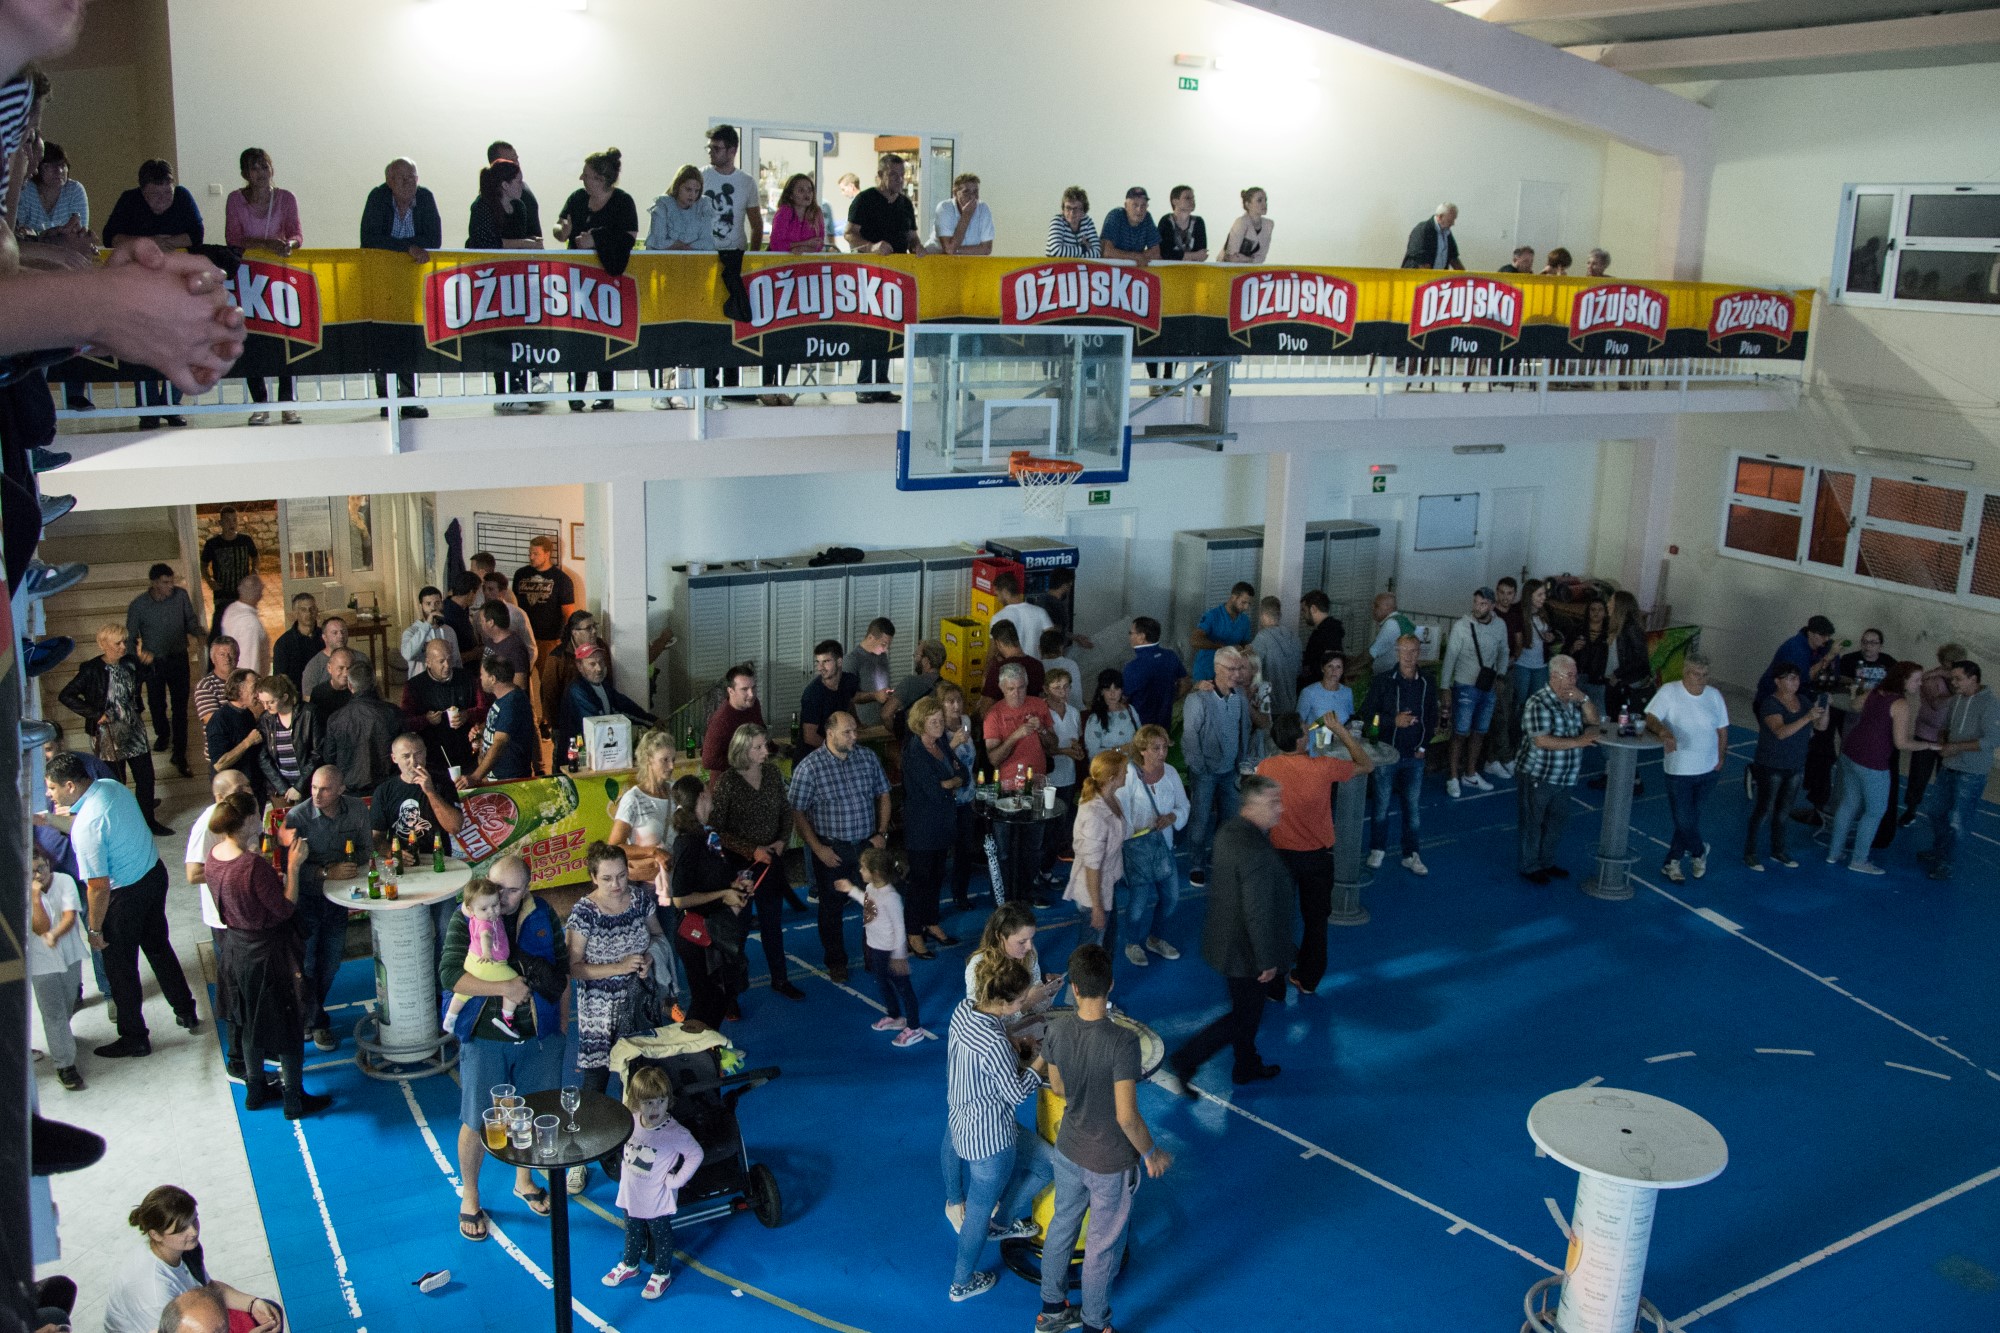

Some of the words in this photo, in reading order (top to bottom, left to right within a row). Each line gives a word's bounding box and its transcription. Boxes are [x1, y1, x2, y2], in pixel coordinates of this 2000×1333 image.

[443, 264, 622, 330] Ožujsko
[749, 265, 904, 328] Ožujsko
[1014, 264, 1150, 321] Ožujsko
[1240, 272, 1348, 323] Ožujsko
[1420, 279, 1515, 328] Ožujsko
[1578, 287, 1662, 331] Ožujsko
[1715, 293, 1790, 334] Ožujsko
[511, 342, 561, 364] Pivo
[806, 337, 851, 358] Pivo
[1063, 334, 1104, 348] Pvo
[1278, 332, 1308, 351] Pivo
[1450, 335, 1479, 353] Pivo
[1604, 338, 1629, 355] Pivo
[1739, 339, 1761, 356] Pivo
[1025, 552, 1073, 569] Bavaria
[456, 802, 493, 859] Ožujs
